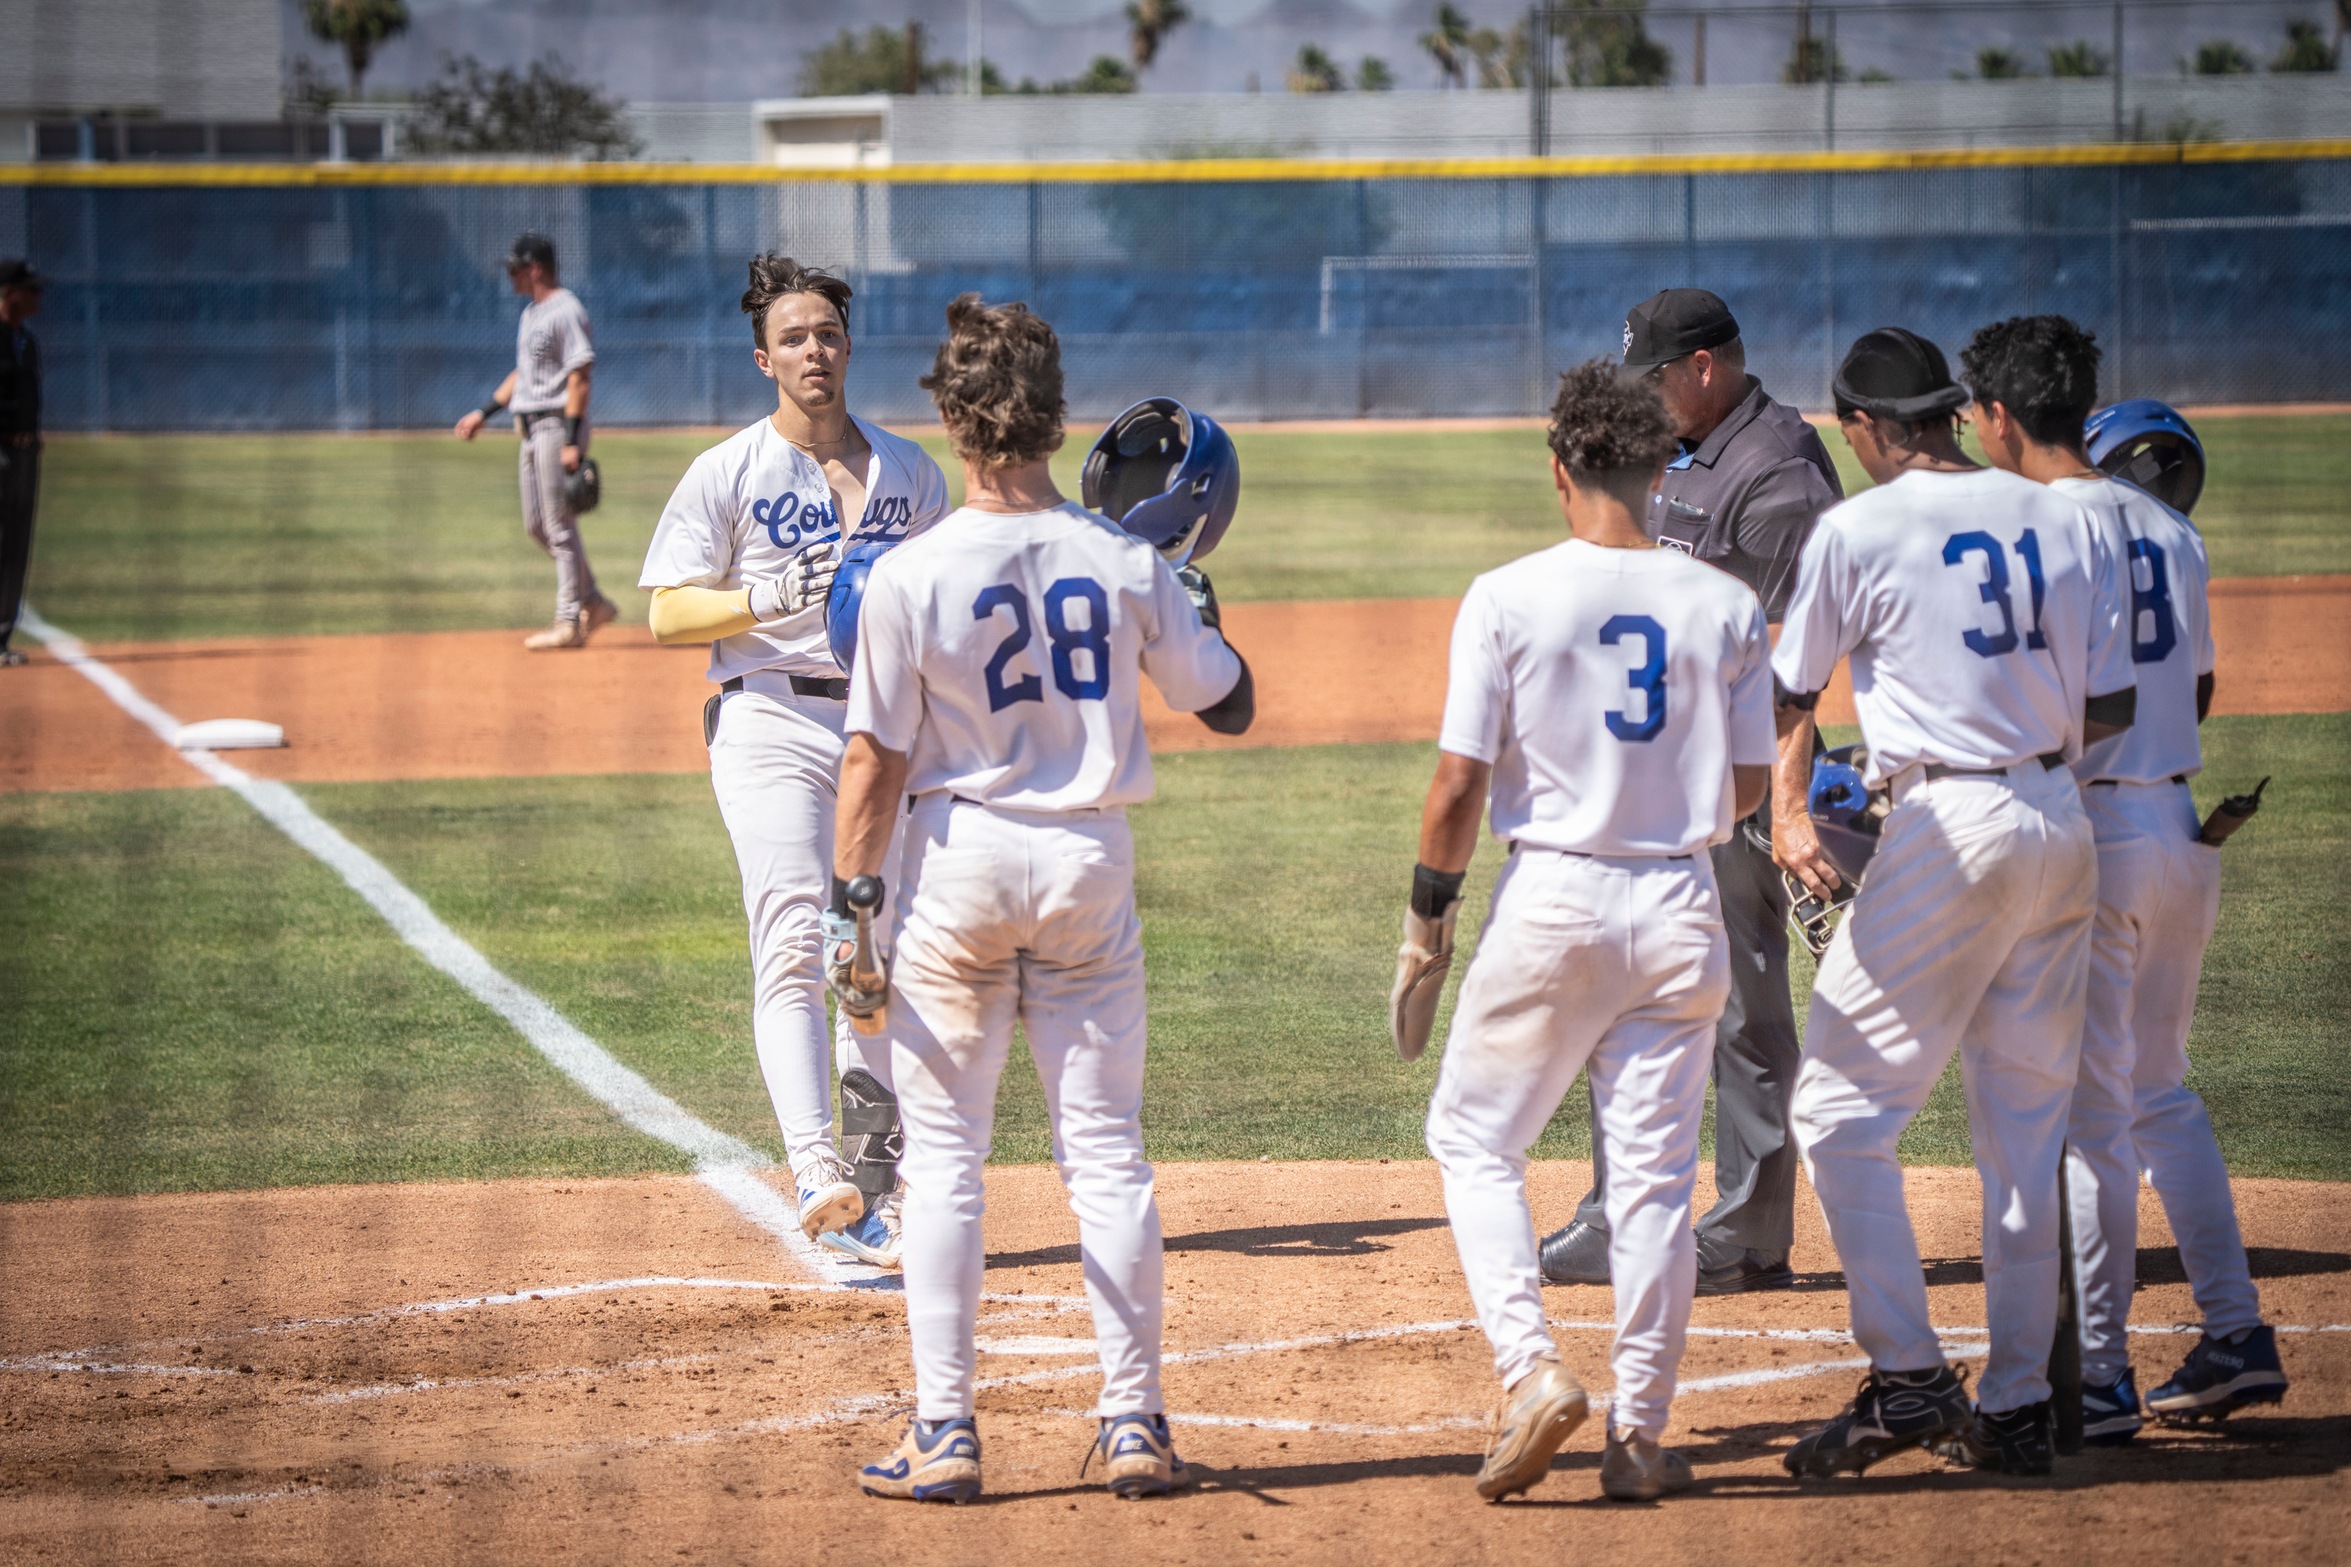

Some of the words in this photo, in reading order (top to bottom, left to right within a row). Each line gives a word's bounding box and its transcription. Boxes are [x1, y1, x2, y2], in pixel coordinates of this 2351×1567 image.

[971, 577, 1110, 713] 28
[1942, 528, 2048, 658] 31
[2127, 537, 2177, 664] 8
[1599, 615, 1667, 743] 3
[1119, 1439, 1144, 1452] NIKE
